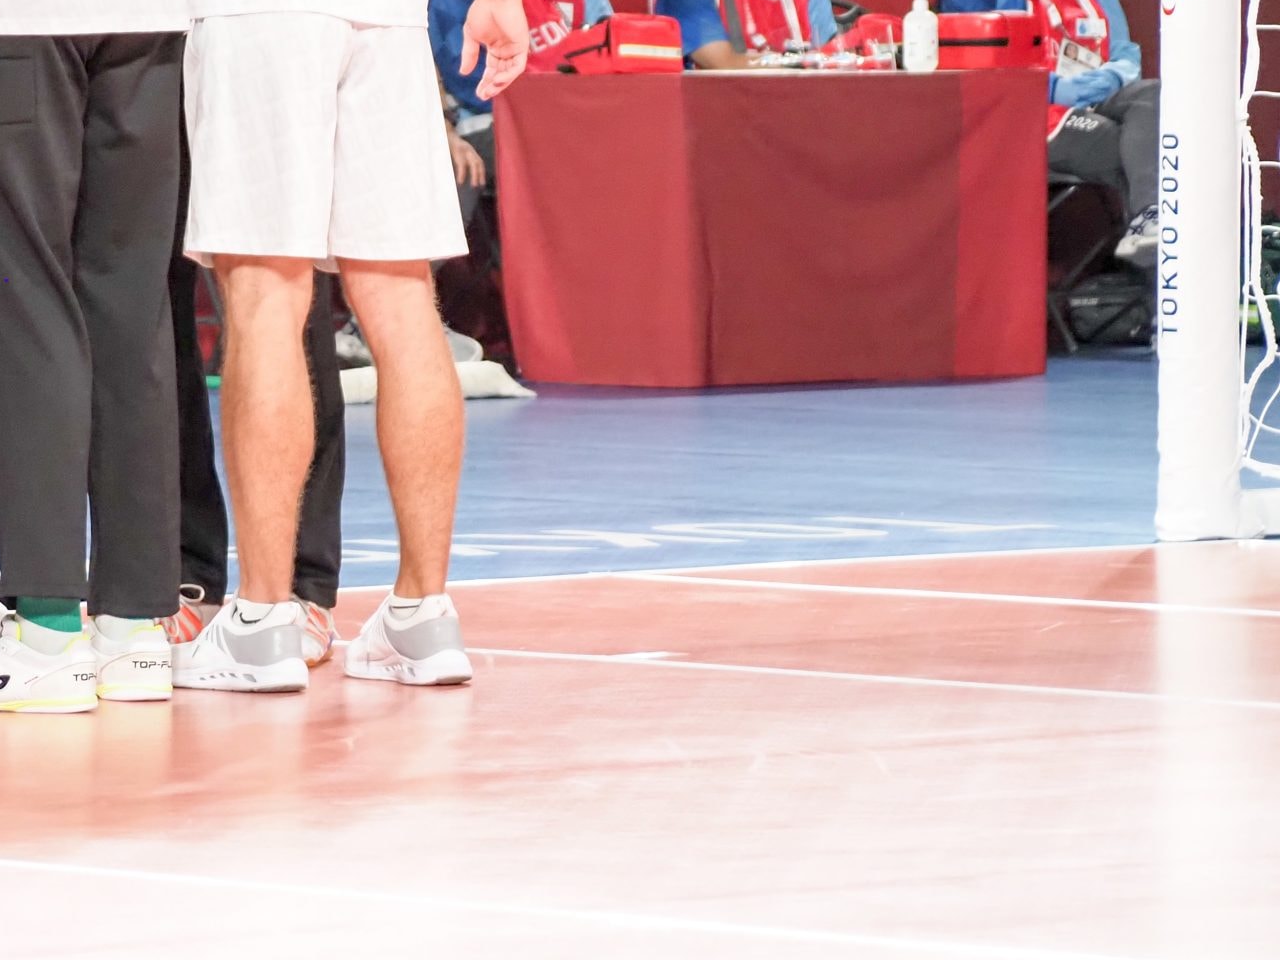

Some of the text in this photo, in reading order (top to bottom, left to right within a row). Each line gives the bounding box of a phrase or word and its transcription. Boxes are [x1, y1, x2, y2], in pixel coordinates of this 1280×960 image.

[1066, 115, 1099, 130] 2020
[1161, 134, 1179, 337] TOKYO 2020
